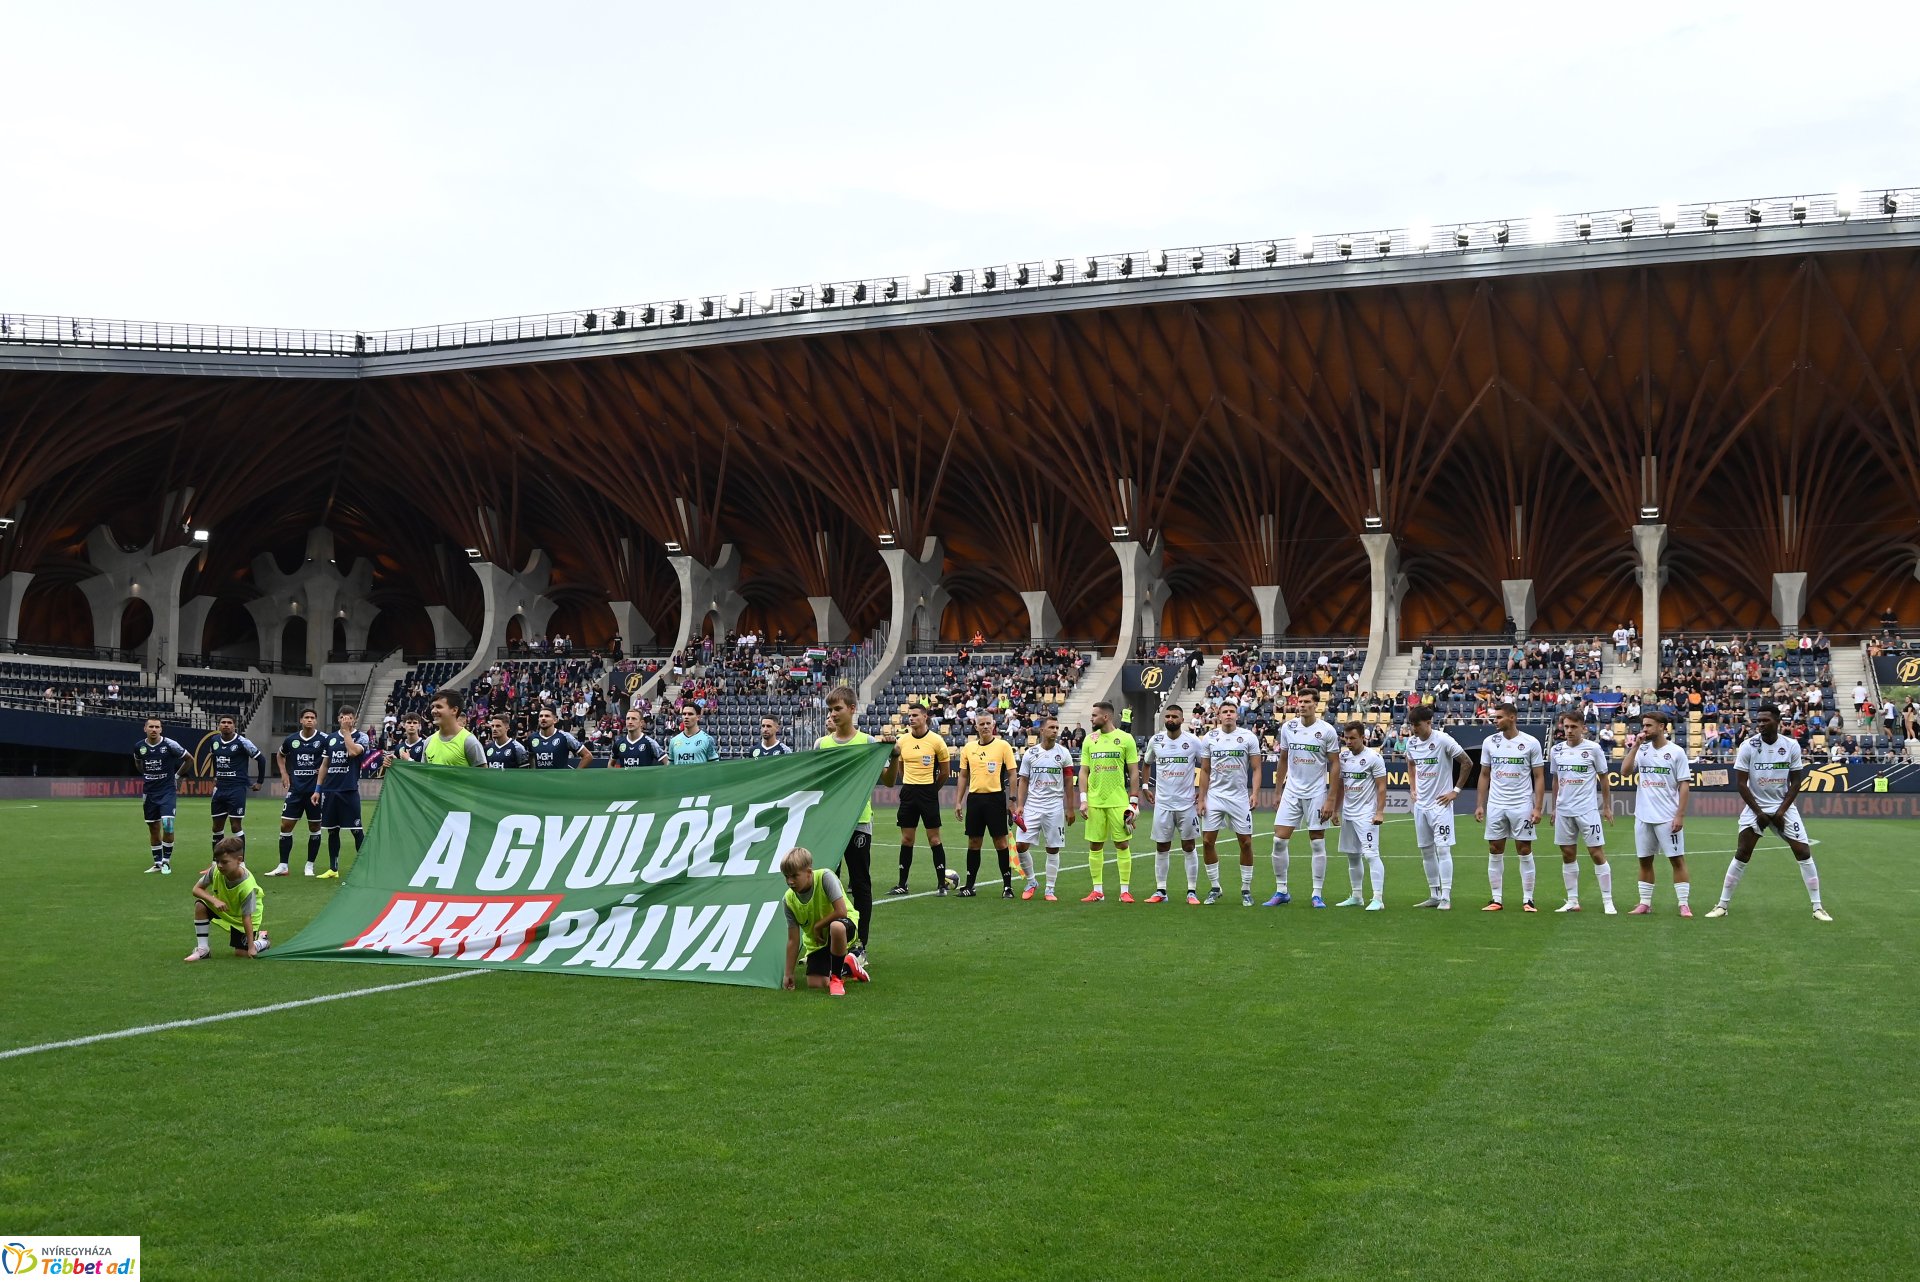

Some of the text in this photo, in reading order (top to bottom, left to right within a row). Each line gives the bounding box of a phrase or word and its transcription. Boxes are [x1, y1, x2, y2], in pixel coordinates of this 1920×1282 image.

[537, 753, 554, 761] MBH
[679, 753, 695, 761] MBH
[1803, 799, 1814, 814] A
[1820, 794, 1906, 816] JÁTÉKOT
[1246, 813, 1251, 823] 4
[1439, 825, 1451, 835] 66
[1589, 824, 1601, 836] 70
[1793, 822, 1800, 832] 8
[408, 790, 824, 891] A GYŰLÖLET
[1366, 832, 1373, 842] 6
[1670, 834, 1678, 845] 11
[350, 894, 779, 972] NEM PÁLYA!
